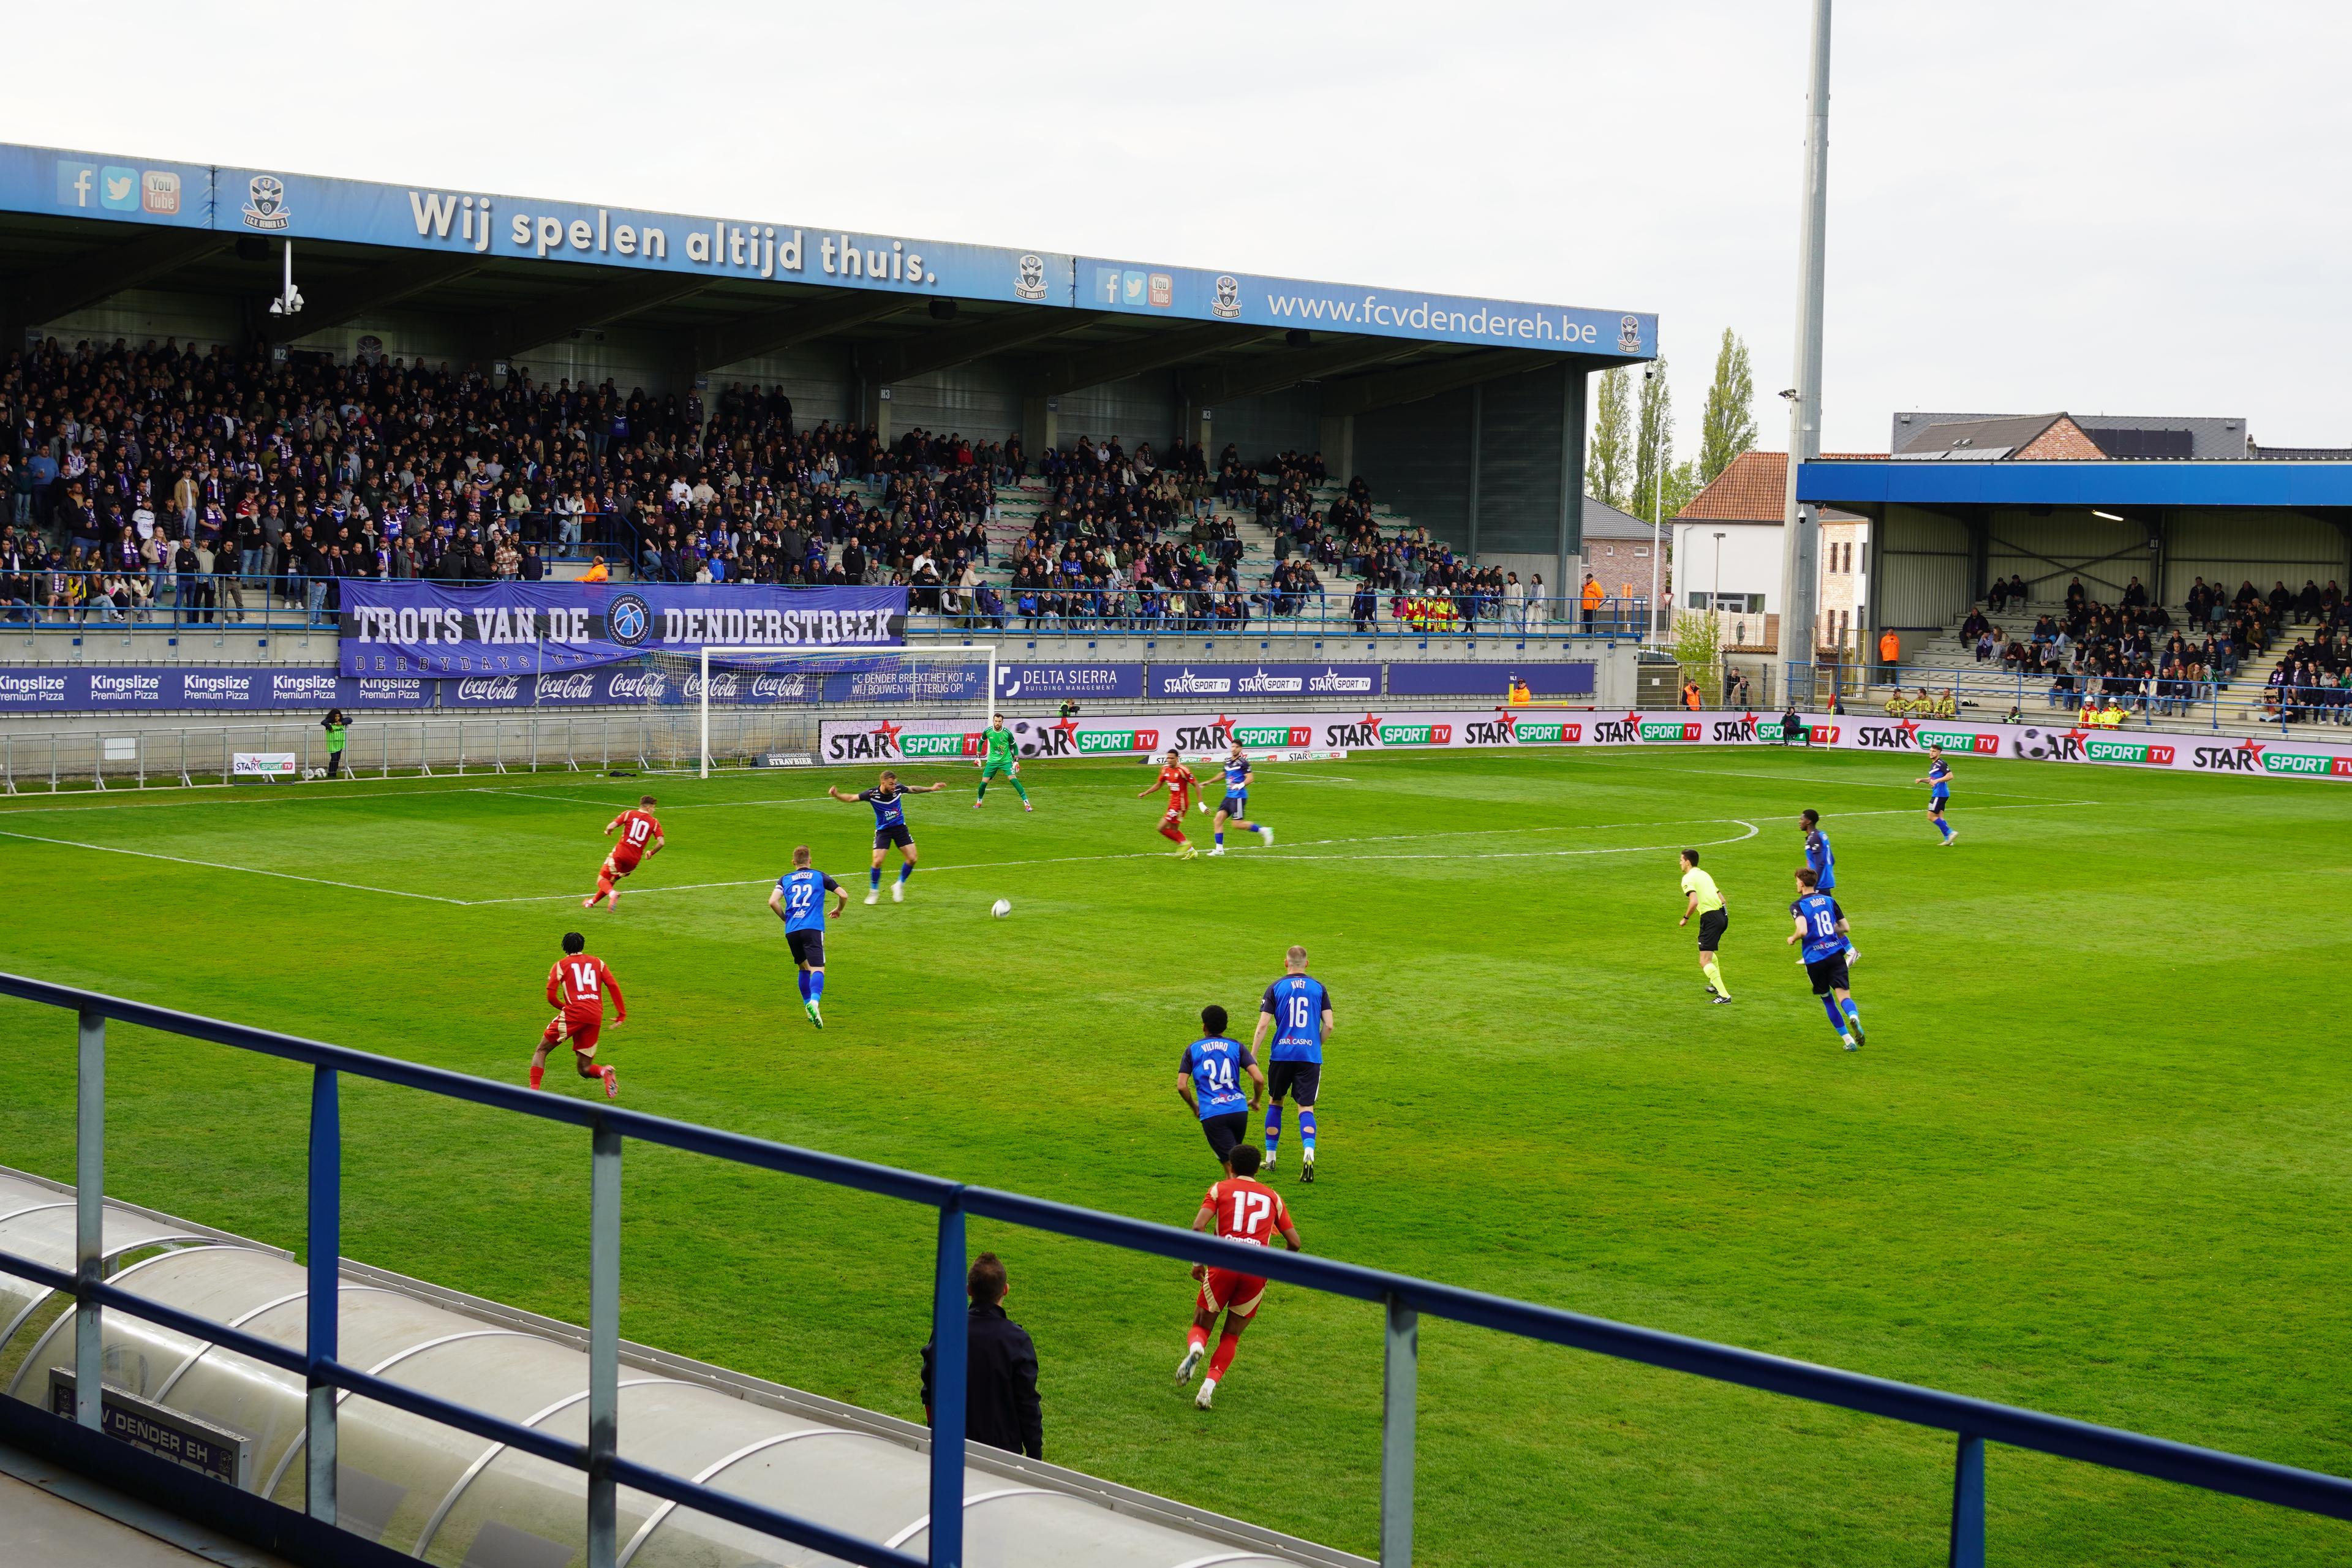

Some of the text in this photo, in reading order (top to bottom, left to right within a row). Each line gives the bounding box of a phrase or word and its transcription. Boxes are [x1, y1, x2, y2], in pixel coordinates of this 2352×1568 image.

[152, 176, 171, 192] You
[149, 193, 175, 209] Tube
[259, 219, 277, 228] DENDER
[409, 191, 935, 283] Wij spelen altijd thuis.
[1154, 278, 1167, 290] You
[1152, 290, 1169, 304] Tube
[1267, 295, 1597, 344] www.fcvdendereh.be
[274, 348, 287, 360] H2
[494, 363, 507, 375] H2
[881, 389, 891, 399] H3
[1202, 410, 1211, 420] H3
[353, 605, 589, 645] TROTS VAN DE
[663, 608, 894, 644] DENDERSTREEK
[91, 675, 159, 692] Kingslize
[184, 675, 250, 691] Kingslize
[273, 675, 336, 692] Kingslize
[609, 673, 668, 698] Coca-Cola
[752, 673, 807, 697] Coca-Cola
[853, 673, 977, 684] FC DENDER BREEKT HET KOT AF,
[1023, 670, 1117, 684] DELTA SIERRA
[1164, 678, 1190, 693] STAR
[1194, 681, 1217, 690] SPORT
[1238, 677, 1264, 692] STAR
[1267, 680, 1289, 689] SPORT
[1309, 677, 1335, 692] STAR
[1338, 680, 1359, 688] SPORT
[184, 690, 249, 699] Premium Pizza
[398, 690, 420, 699] Pizza
[458, 676, 521, 700] Coca-Cola
[535, 673, 597, 699] Coca-Cola
[852, 685, 865, 695] WIJ
[869, 685, 903, 694] BOUWEN
[923, 684, 949, 693] TERUG
[950, 684, 963, 693] OP!
[0, 692, 64, 701] remium Pizza
[91, 691, 159, 700] Premium Pizza
[273, 691, 311, 699] Premium
[1175, 727, 1308, 751] STAR SPORT TV
[1326, 723, 1449, 747] STAR SPORT TV
[1464, 722, 1579, 744] STAR SPORT TV
[1594, 722, 1700, 743] STAR SPORT TV
[1713, 722, 1753, 742] STAR
[1817, 729, 1836, 740] TV
[1857, 726, 1996, 750] STAR SPORT TV
[829, 733, 892, 759] STAR
[905, 736, 961, 753] SPORT
[1081, 733, 1133, 750] SPORT
[1137, 733, 1156, 750] TV
[2090, 744, 2145, 761] SPORT
[2152, 749, 2171, 761] TV
[2193, 747, 2255, 772] STAR
[2268, 755, 2332, 772] SPORT
[236, 762, 257, 771] STAR
[628, 818, 649, 842] 10
[791, 884, 812, 908] 22
[1814, 910, 1834, 937] 18
[571, 963, 598, 992] 14
[1289, 997, 1308, 1028] 16
[1203, 1058, 1234, 1091] 24
[1211, 1096, 1227, 1104] STAR
[1232, 1190, 1271, 1234] 17
[115, 1412, 181, 1452] DENDER
[186, 1440, 208, 1464] EH
